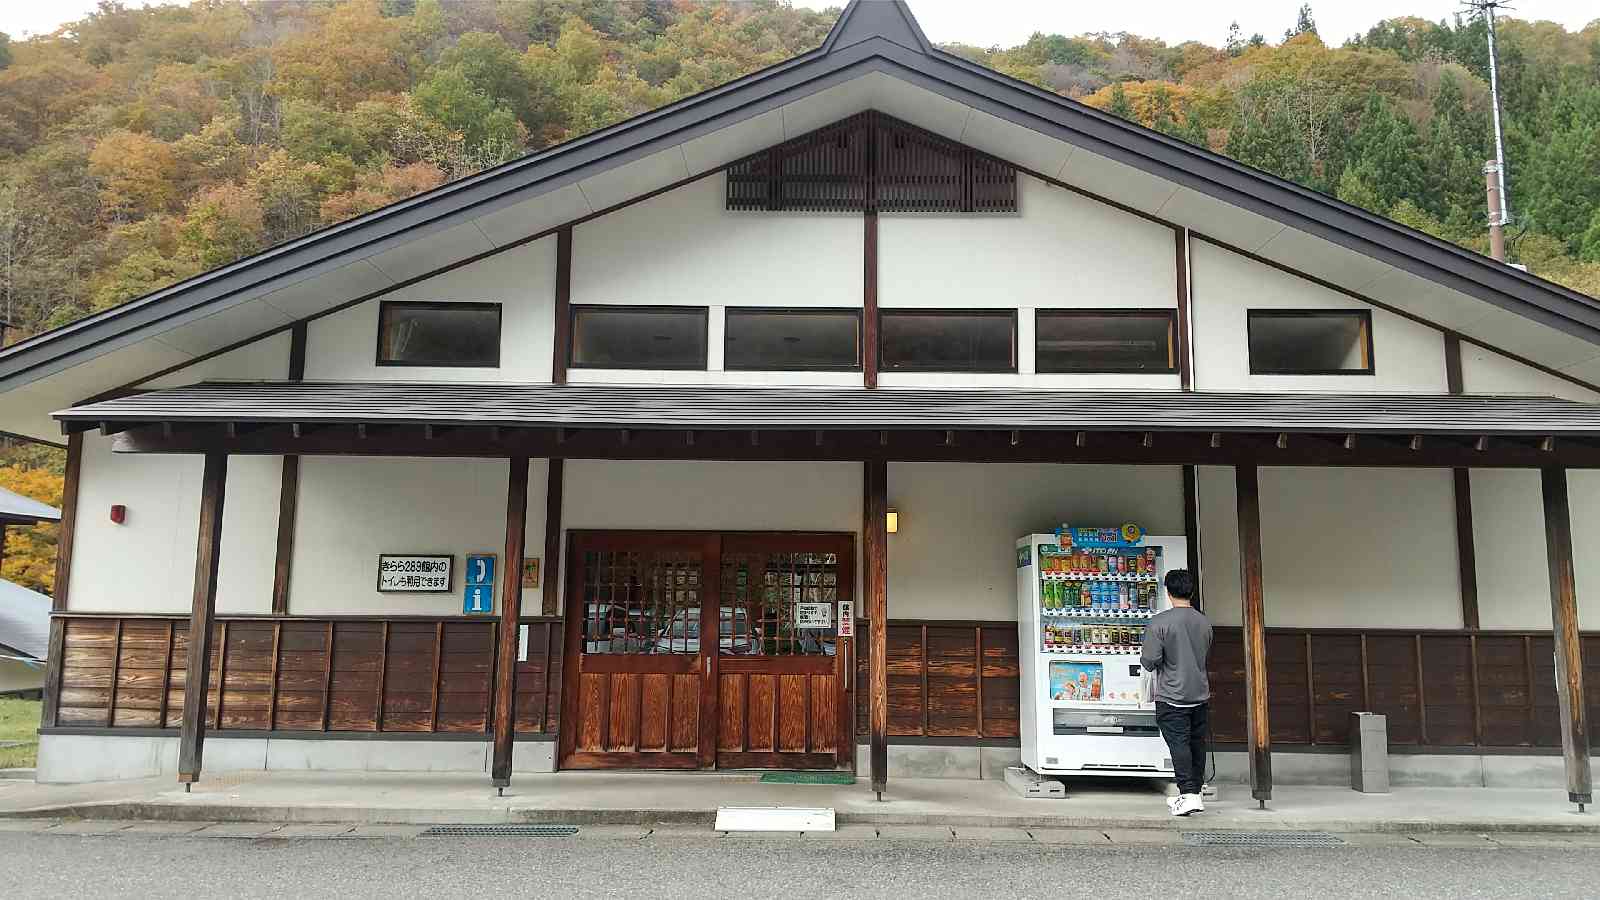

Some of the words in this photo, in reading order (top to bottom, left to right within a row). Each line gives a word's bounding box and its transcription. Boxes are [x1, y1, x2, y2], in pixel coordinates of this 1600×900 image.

[382, 560, 447, 572] きらら289館内の
